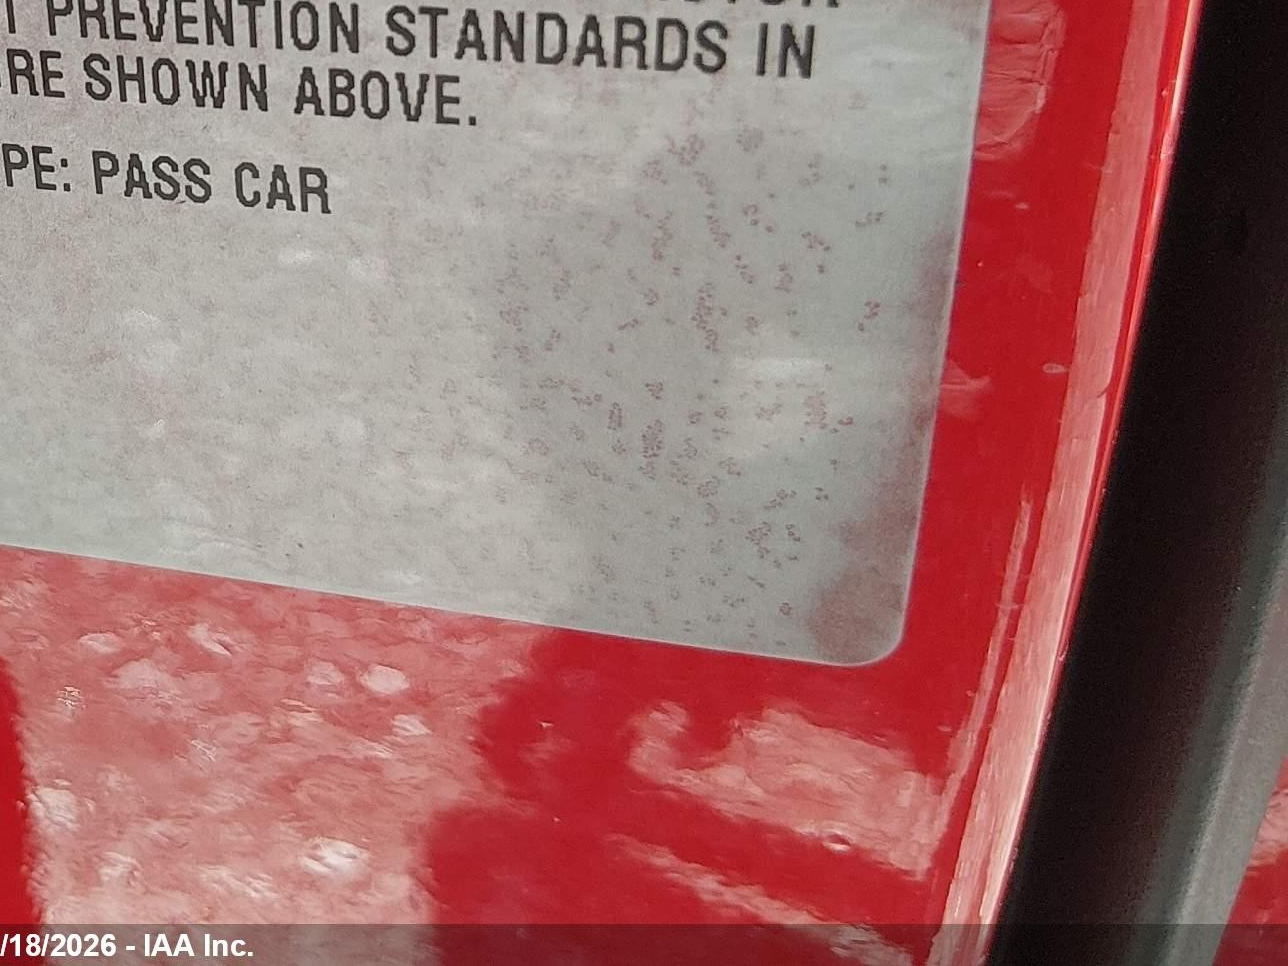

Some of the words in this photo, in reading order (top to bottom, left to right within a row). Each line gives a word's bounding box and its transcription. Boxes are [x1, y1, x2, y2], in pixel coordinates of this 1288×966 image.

[385, 5, 729, 74] STANDARDS
[754, 21, 815, 79] IN
[83, 52, 269, 112] SHOWN
[294, 67, 478, 126] ABOVE.
[91, 149, 212, 203] PASS
[233, 161, 332, 214] CAR
